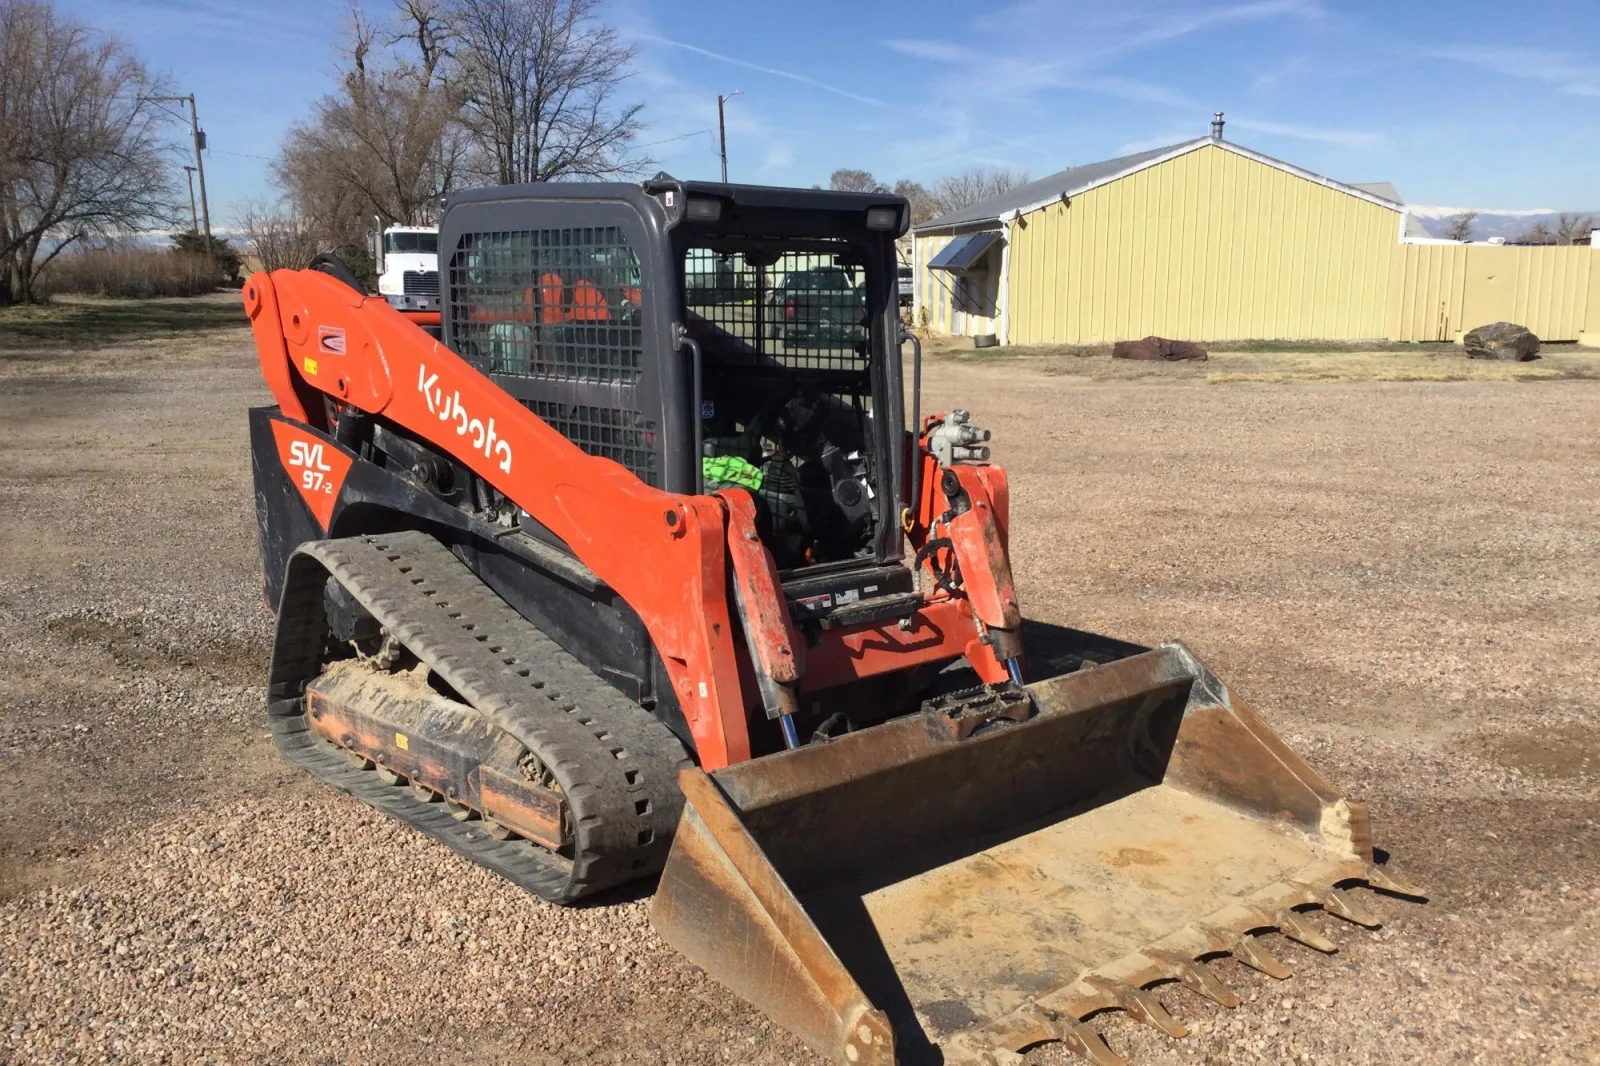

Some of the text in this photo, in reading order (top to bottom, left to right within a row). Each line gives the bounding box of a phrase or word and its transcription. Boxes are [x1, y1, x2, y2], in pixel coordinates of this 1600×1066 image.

[418, 363, 512, 475] Kubota
[289, 440, 331, 471] SVL
[302, 470, 333, 494] 97-2
